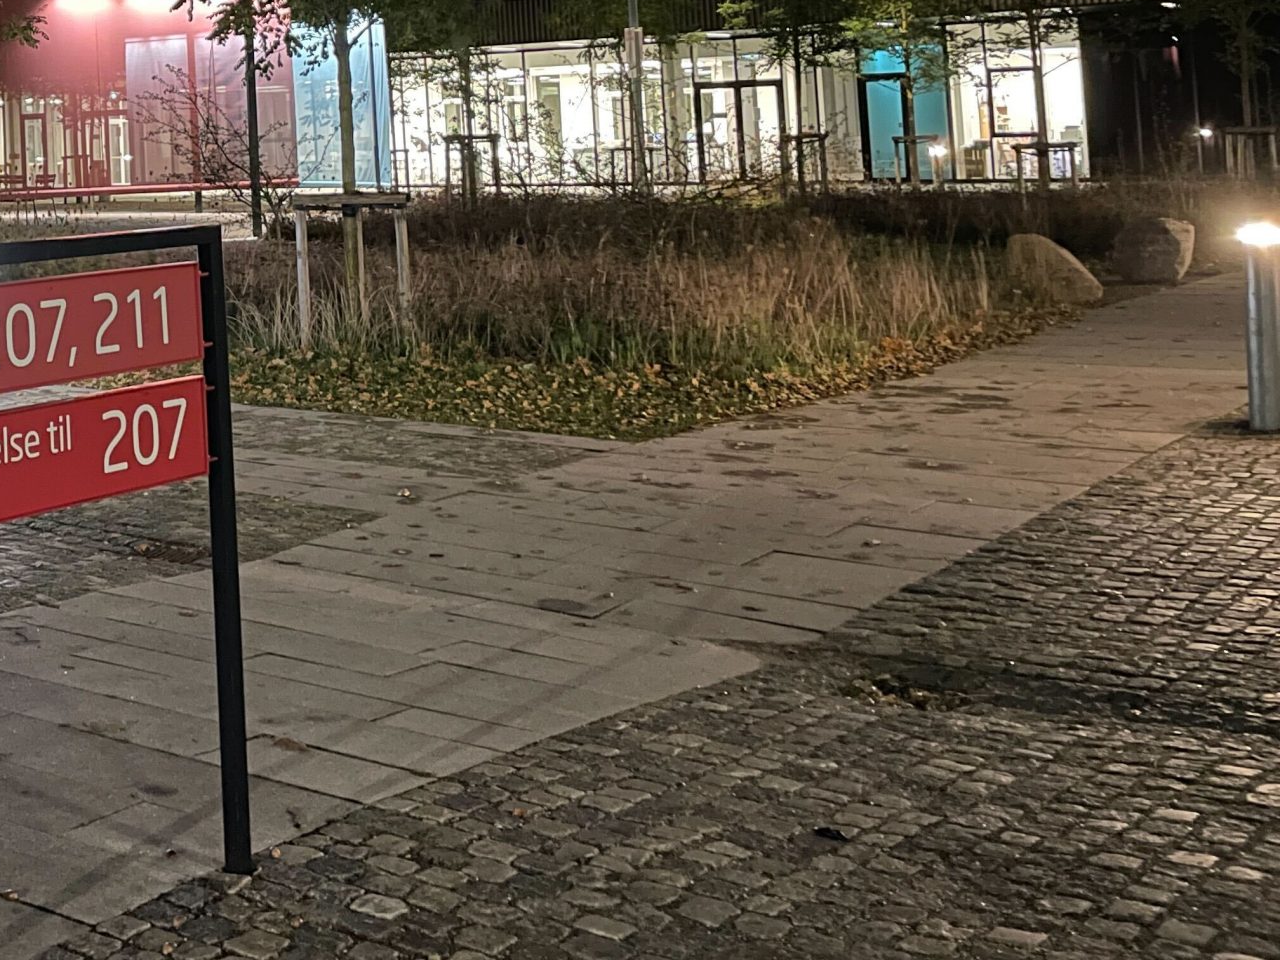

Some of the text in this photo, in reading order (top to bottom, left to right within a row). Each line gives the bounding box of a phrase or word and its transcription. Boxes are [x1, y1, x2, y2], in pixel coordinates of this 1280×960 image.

[93, 285, 170, 355] 211
[46, 415, 72, 455] til
[101, 397, 187, 474] 207
